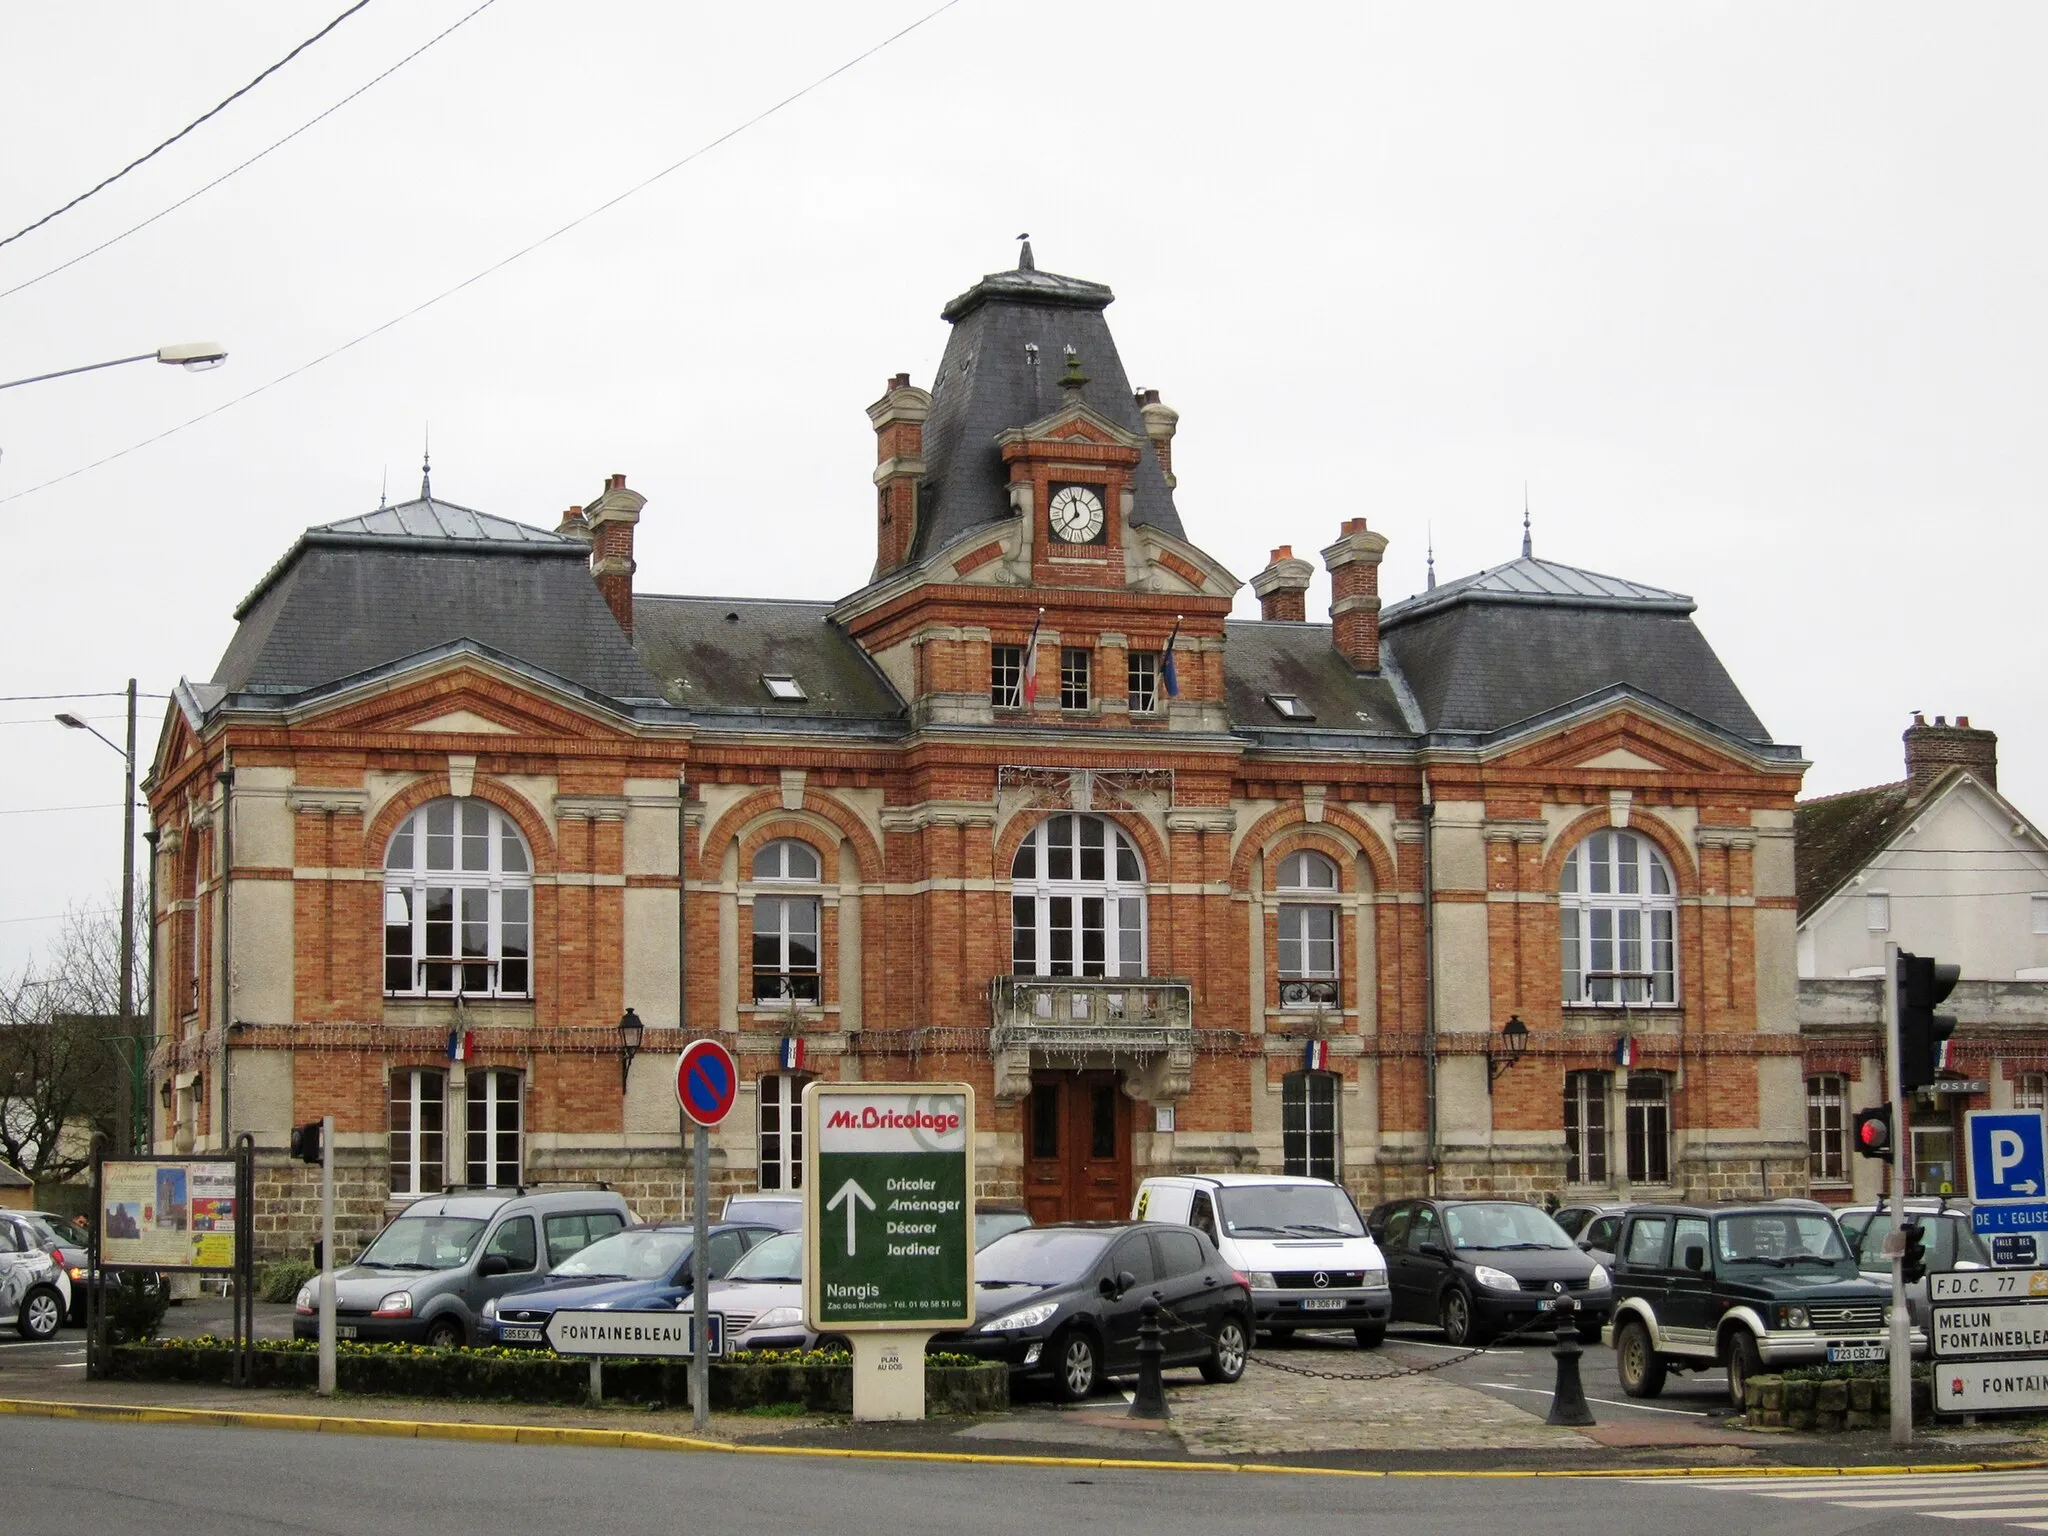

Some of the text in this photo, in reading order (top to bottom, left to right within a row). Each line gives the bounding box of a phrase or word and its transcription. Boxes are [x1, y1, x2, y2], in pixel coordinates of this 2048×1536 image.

[1990, 1129, 2025, 1184] P
[886, 1177, 936, 1191] Bricoler
[886, 1195, 960, 1213] Aménager
[1976, 1213, 1991, 1225] DE
[886, 1221, 937, 1234] Décorer
[887, 1242, 941, 1256] Jardiner
[827, 1283, 880, 1300] Nangis
[1937, 1277, 2016, 1294] F.D.C. 77
[909, 1300, 918, 1308] 01
[1940, 1313, 1991, 1329] MELUN
[560, 1326, 682, 1341] FONTAINEBLEAU
[1834, 1347, 1884, 1360] 723 CBZ 77
